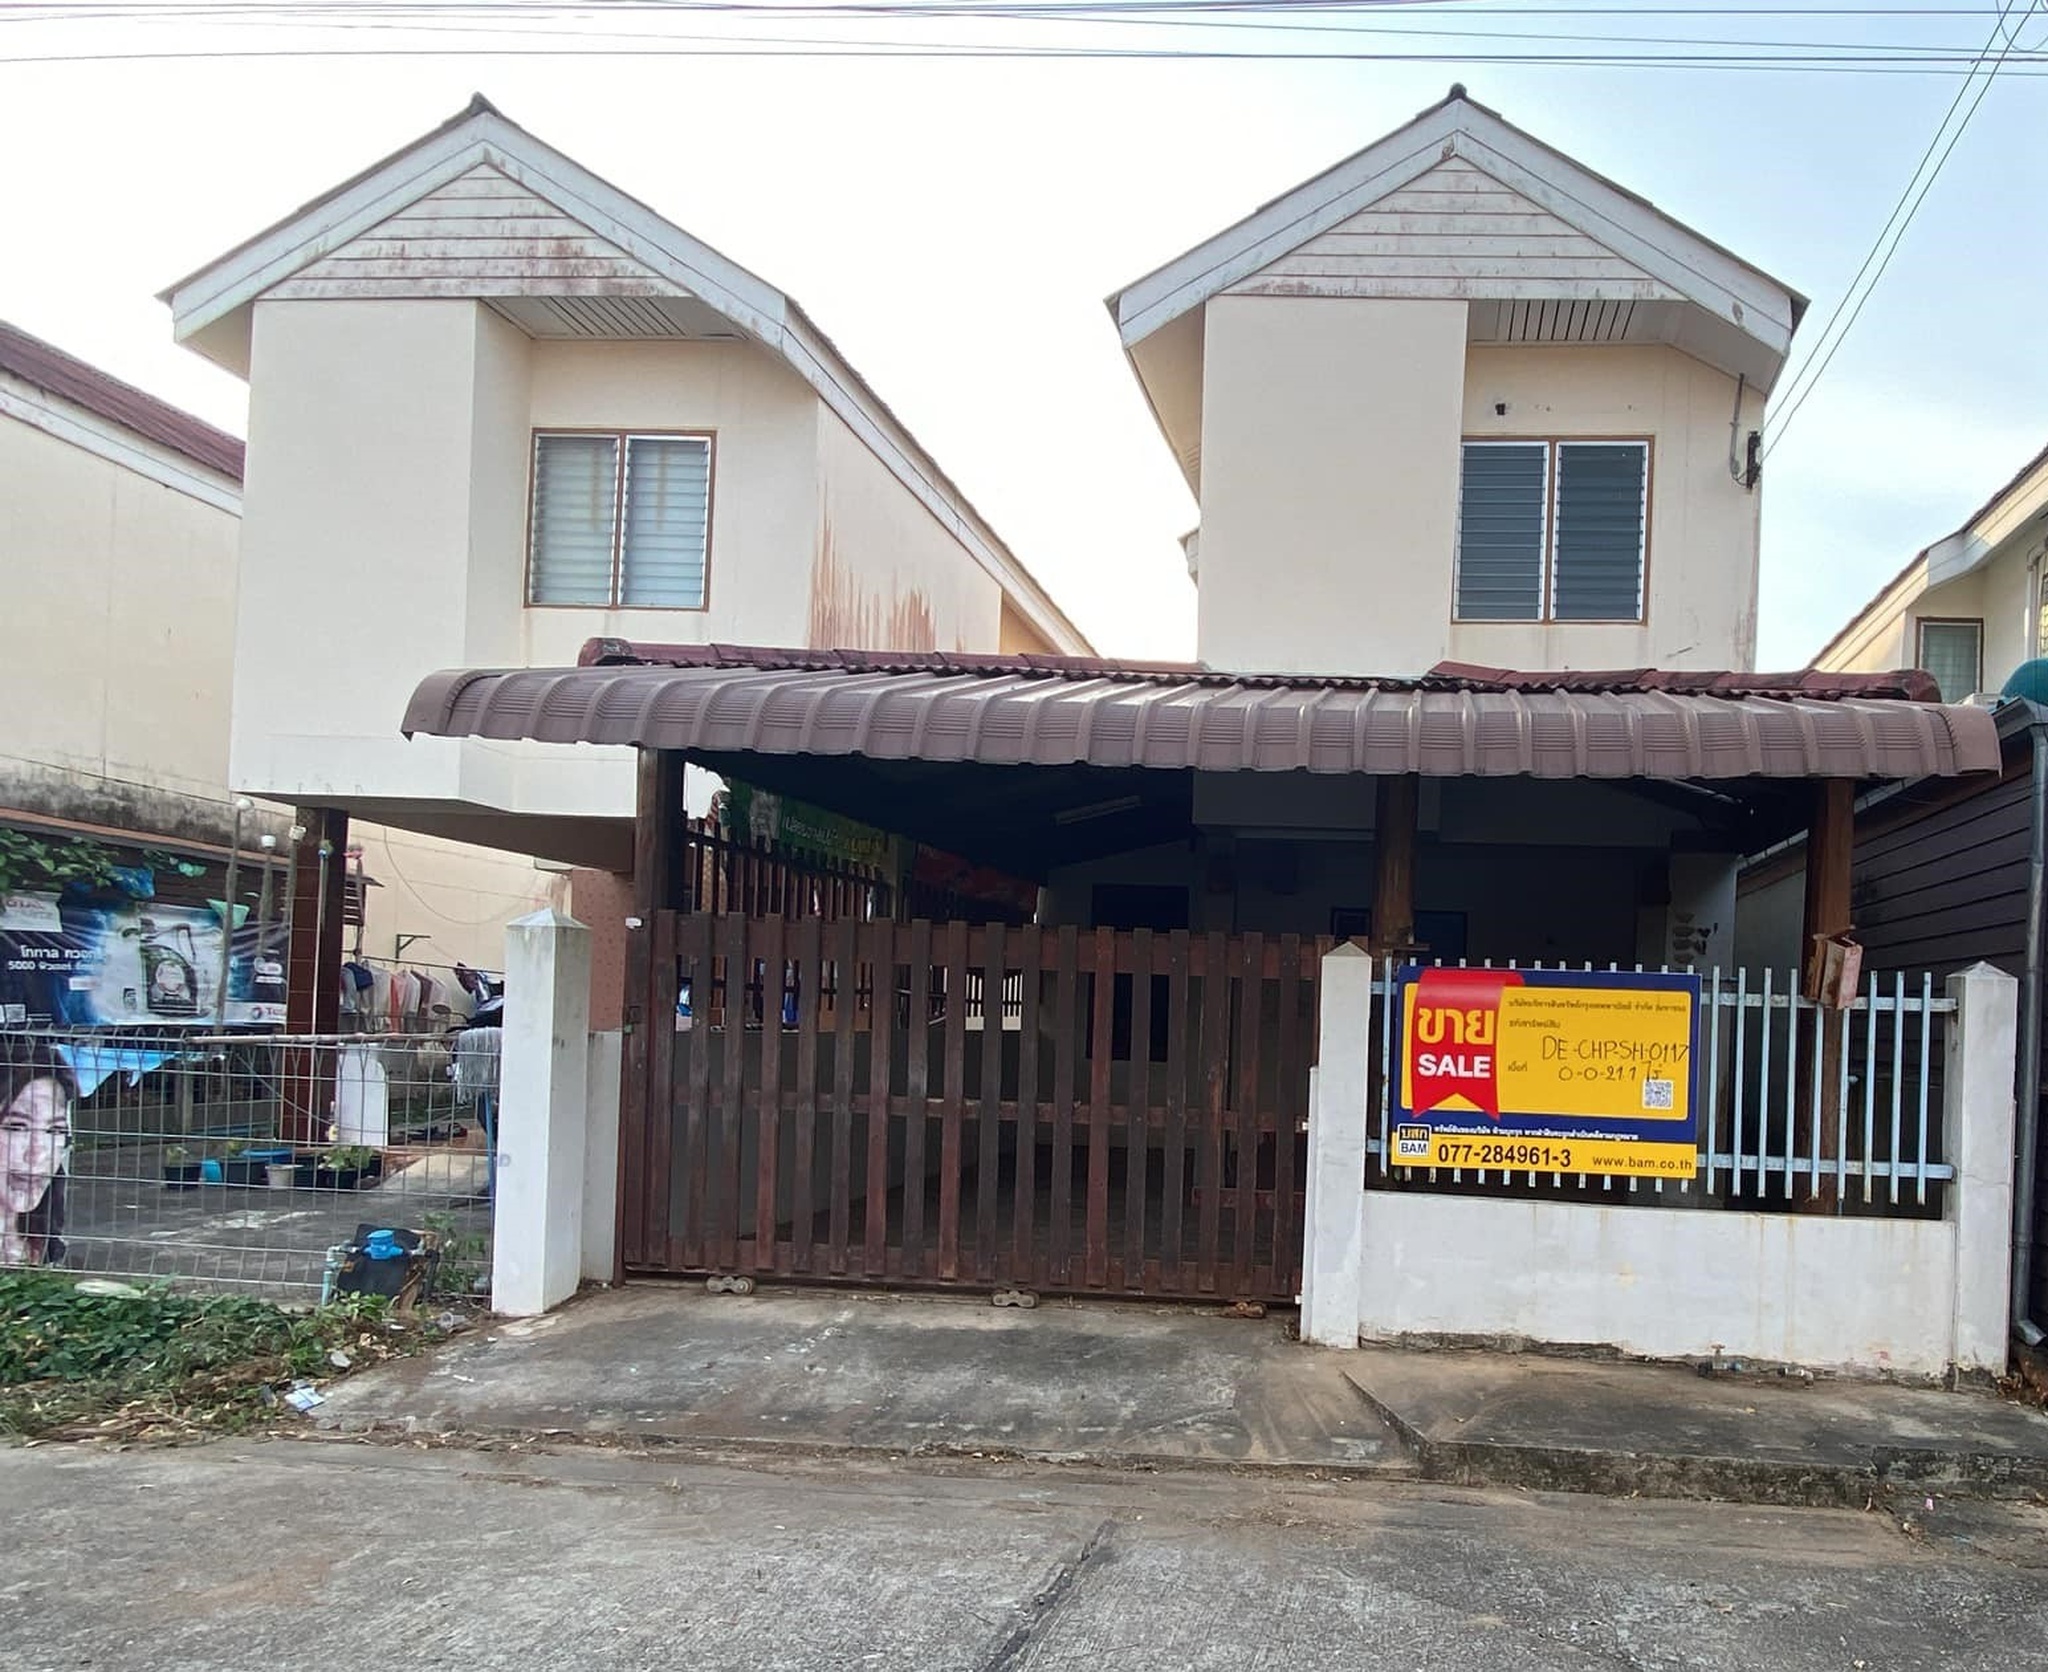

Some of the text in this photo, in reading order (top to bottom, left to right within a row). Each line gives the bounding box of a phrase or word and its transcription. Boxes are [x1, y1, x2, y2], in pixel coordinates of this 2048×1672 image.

[8, 960, 36, 970] 5000
[1418, 1007, 1495, 1045] ขาย
[1418, 1053, 1491, 1079] SALE
[1400, 1142, 1427, 1154] BAM
[1438, 1143, 1571, 1168] 077-284961-3
[1592, 1155, 1693, 1170] www.bam.co.th
